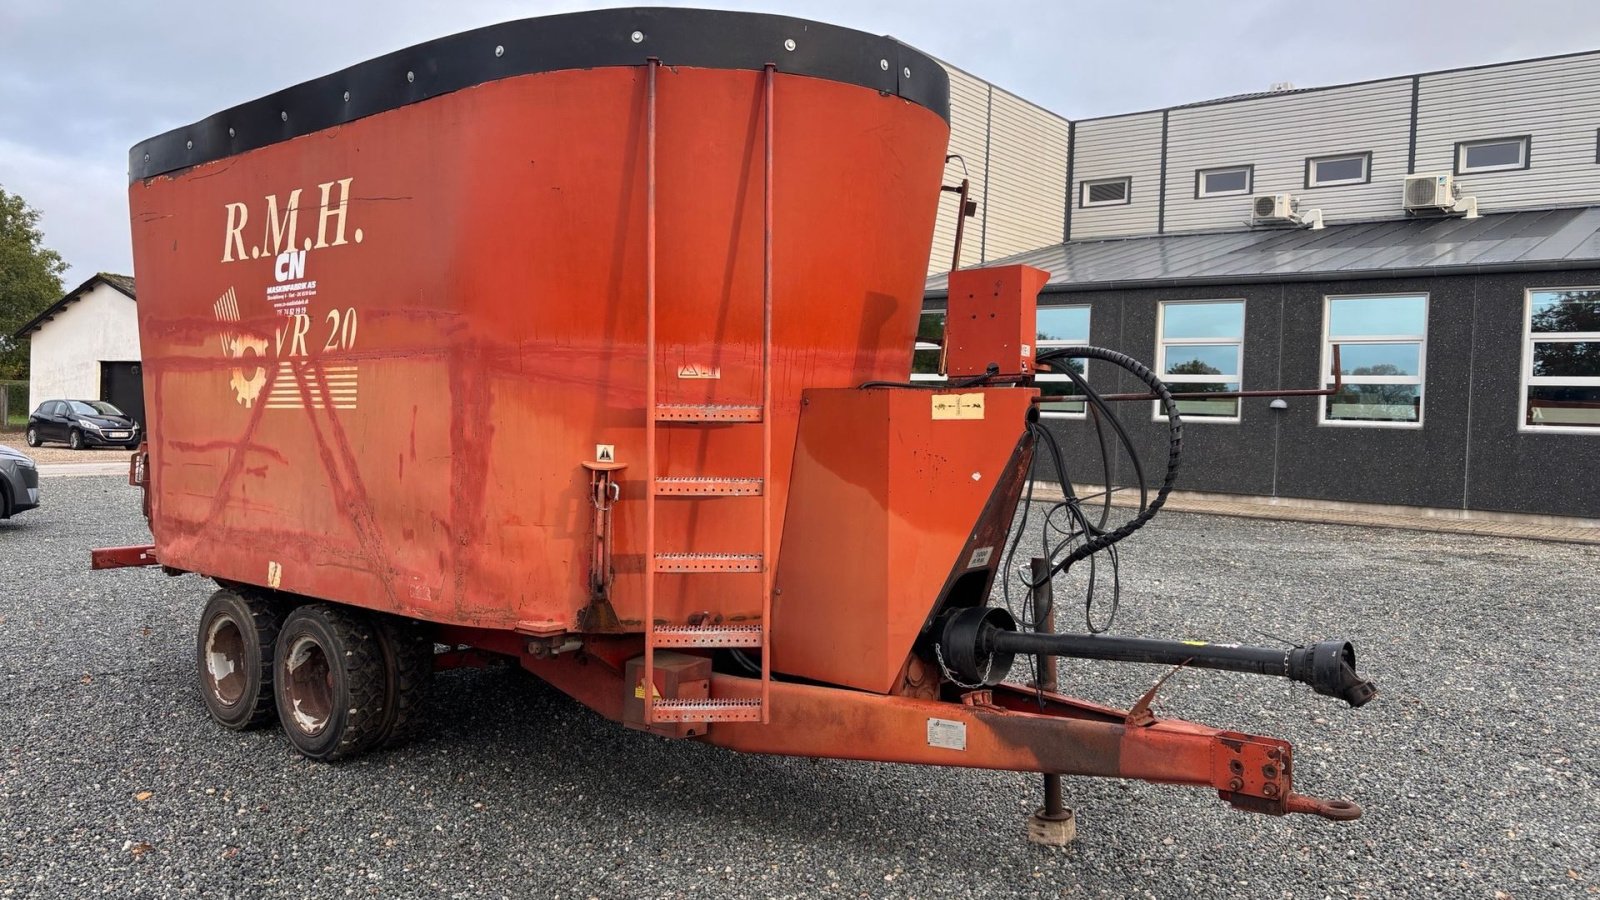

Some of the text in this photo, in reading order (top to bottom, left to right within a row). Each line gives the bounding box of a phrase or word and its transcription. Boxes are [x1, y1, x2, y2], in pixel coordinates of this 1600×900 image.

[221, 177, 364, 263] R.M.H.
[275, 250, 306, 282] CN
[276, 307, 357, 358] VR 20
